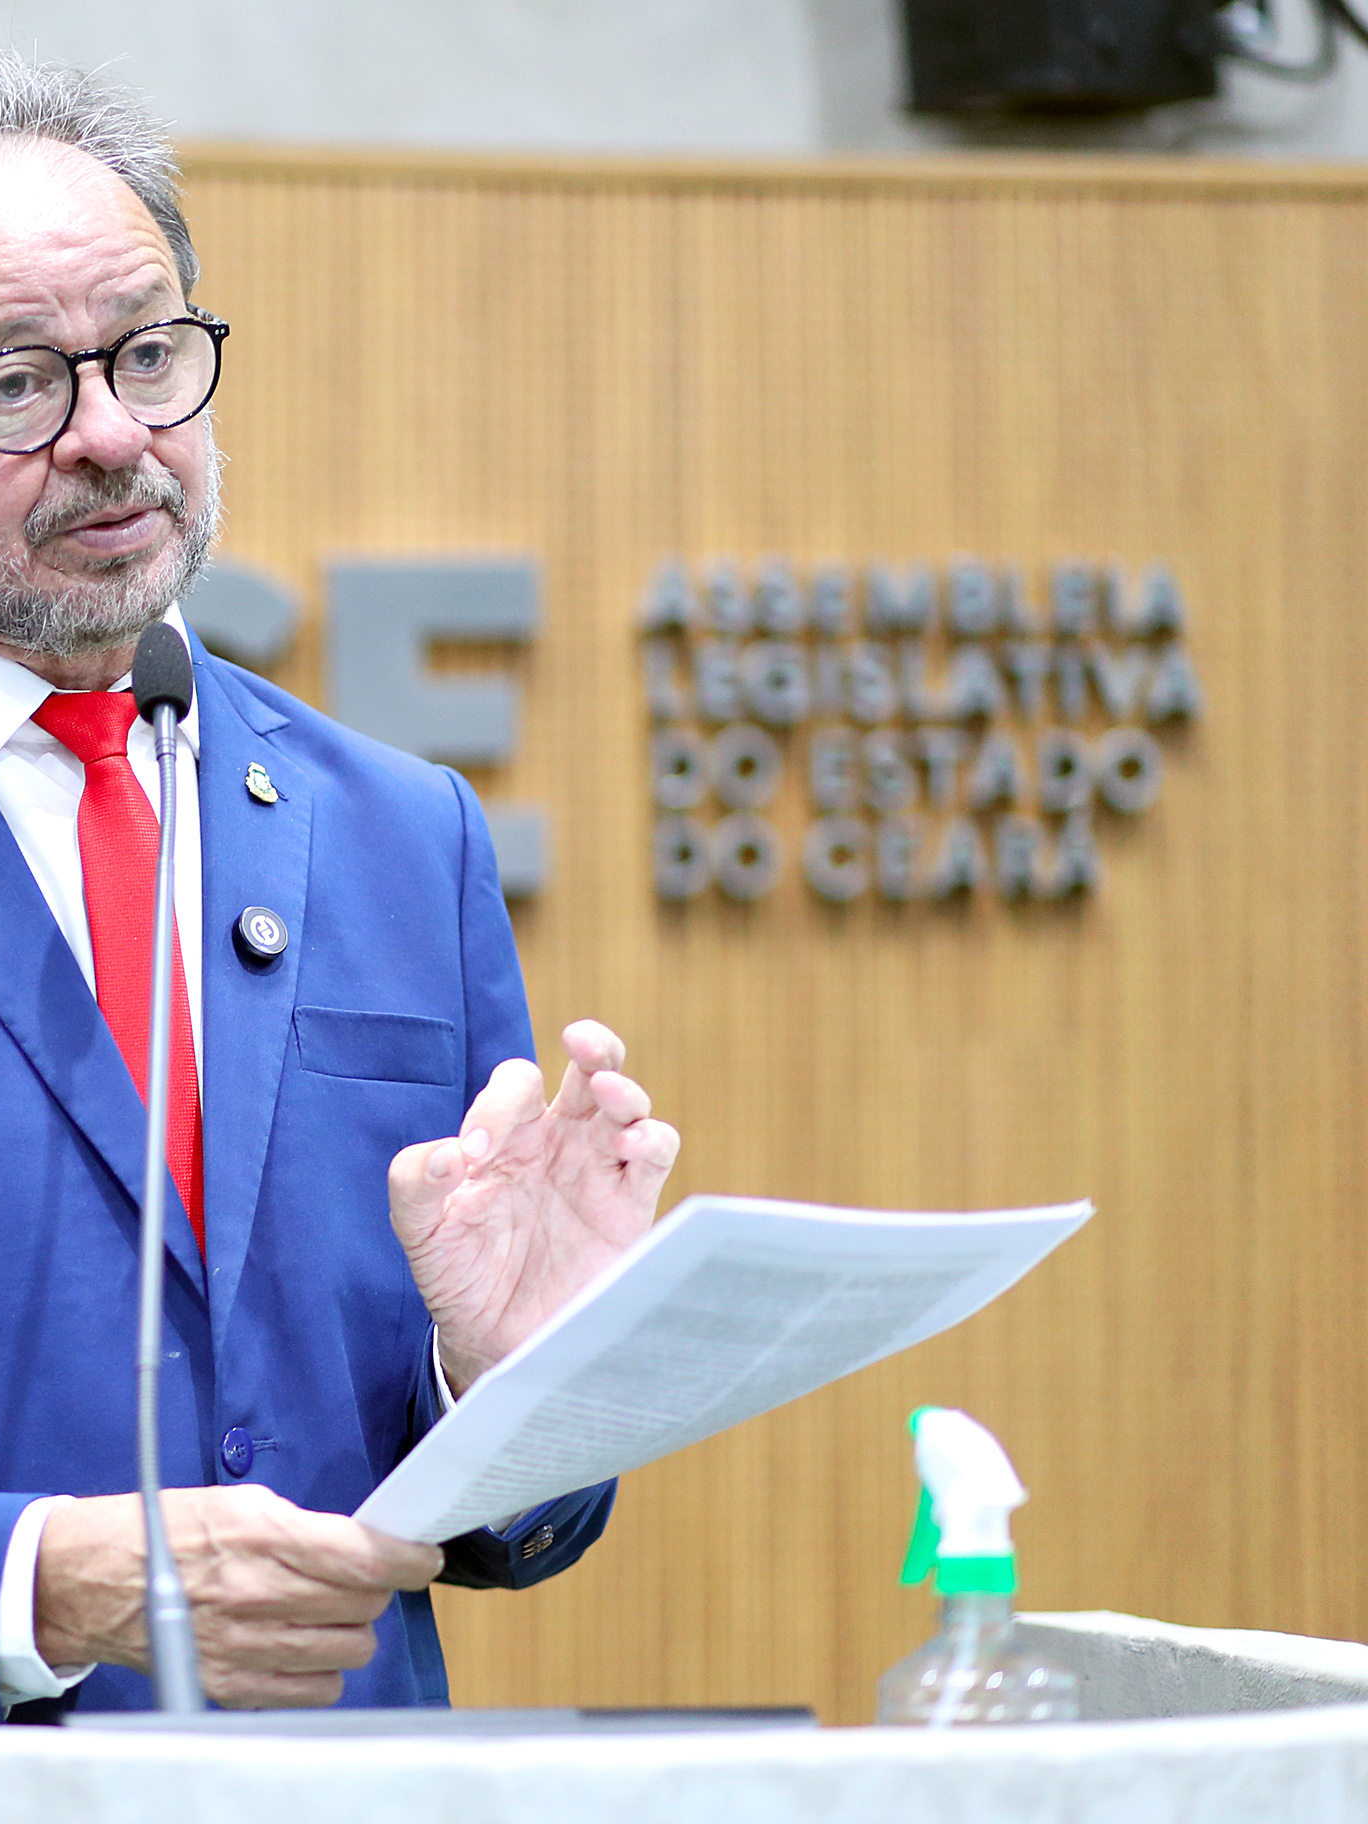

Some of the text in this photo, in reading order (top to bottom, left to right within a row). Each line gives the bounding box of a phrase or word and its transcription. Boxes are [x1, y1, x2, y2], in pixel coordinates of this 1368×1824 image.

[644, 640, 1202, 722] LEGISLATIVA
[651, 726, 1164, 812] DO ESTADO
[653, 813, 783, 900] DO
